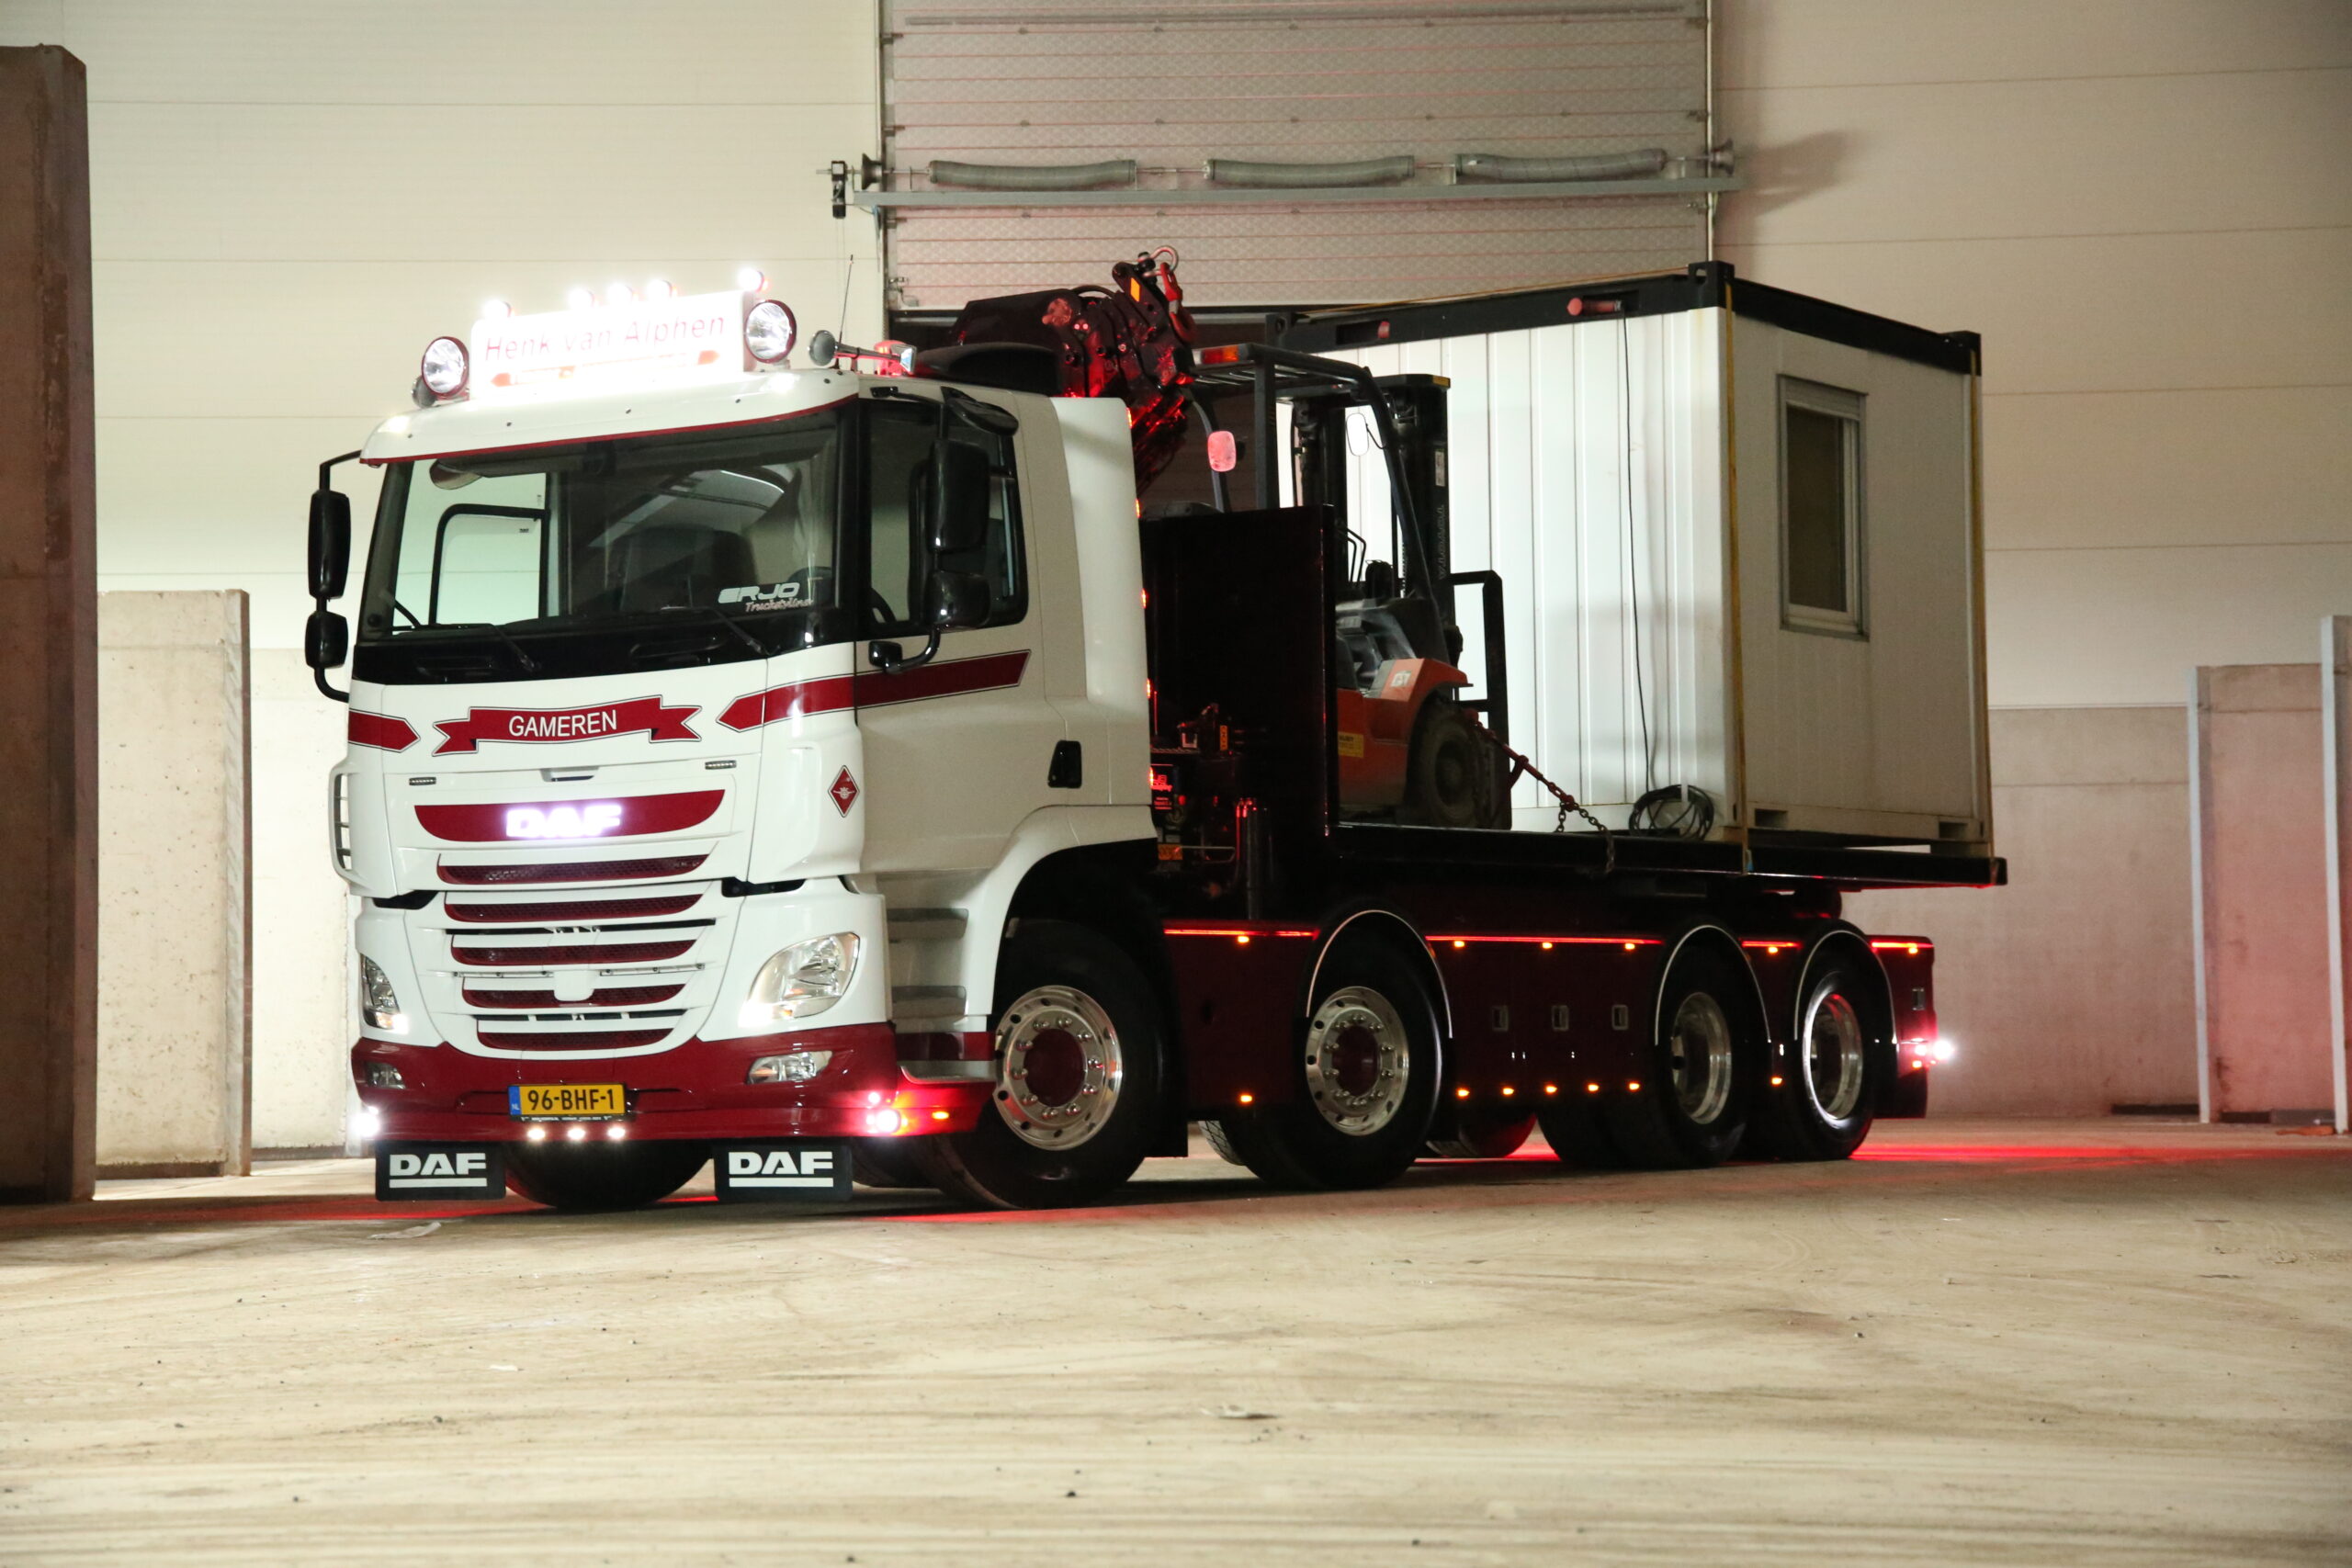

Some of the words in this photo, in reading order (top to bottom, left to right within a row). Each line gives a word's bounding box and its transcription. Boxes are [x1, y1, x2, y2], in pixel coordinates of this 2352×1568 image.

[485, 335, 550, 362] Henk
[564, 330, 612, 353] van
[625, 317, 726, 346] Alphen
[508, 709, 617, 737] GAMEREN
[506, 805, 622, 838] DAF
[527, 1089, 614, 1111] 96-BHF-1
[389, 1153, 487, 1176] DAF
[729, 1151, 833, 1175] DAF
